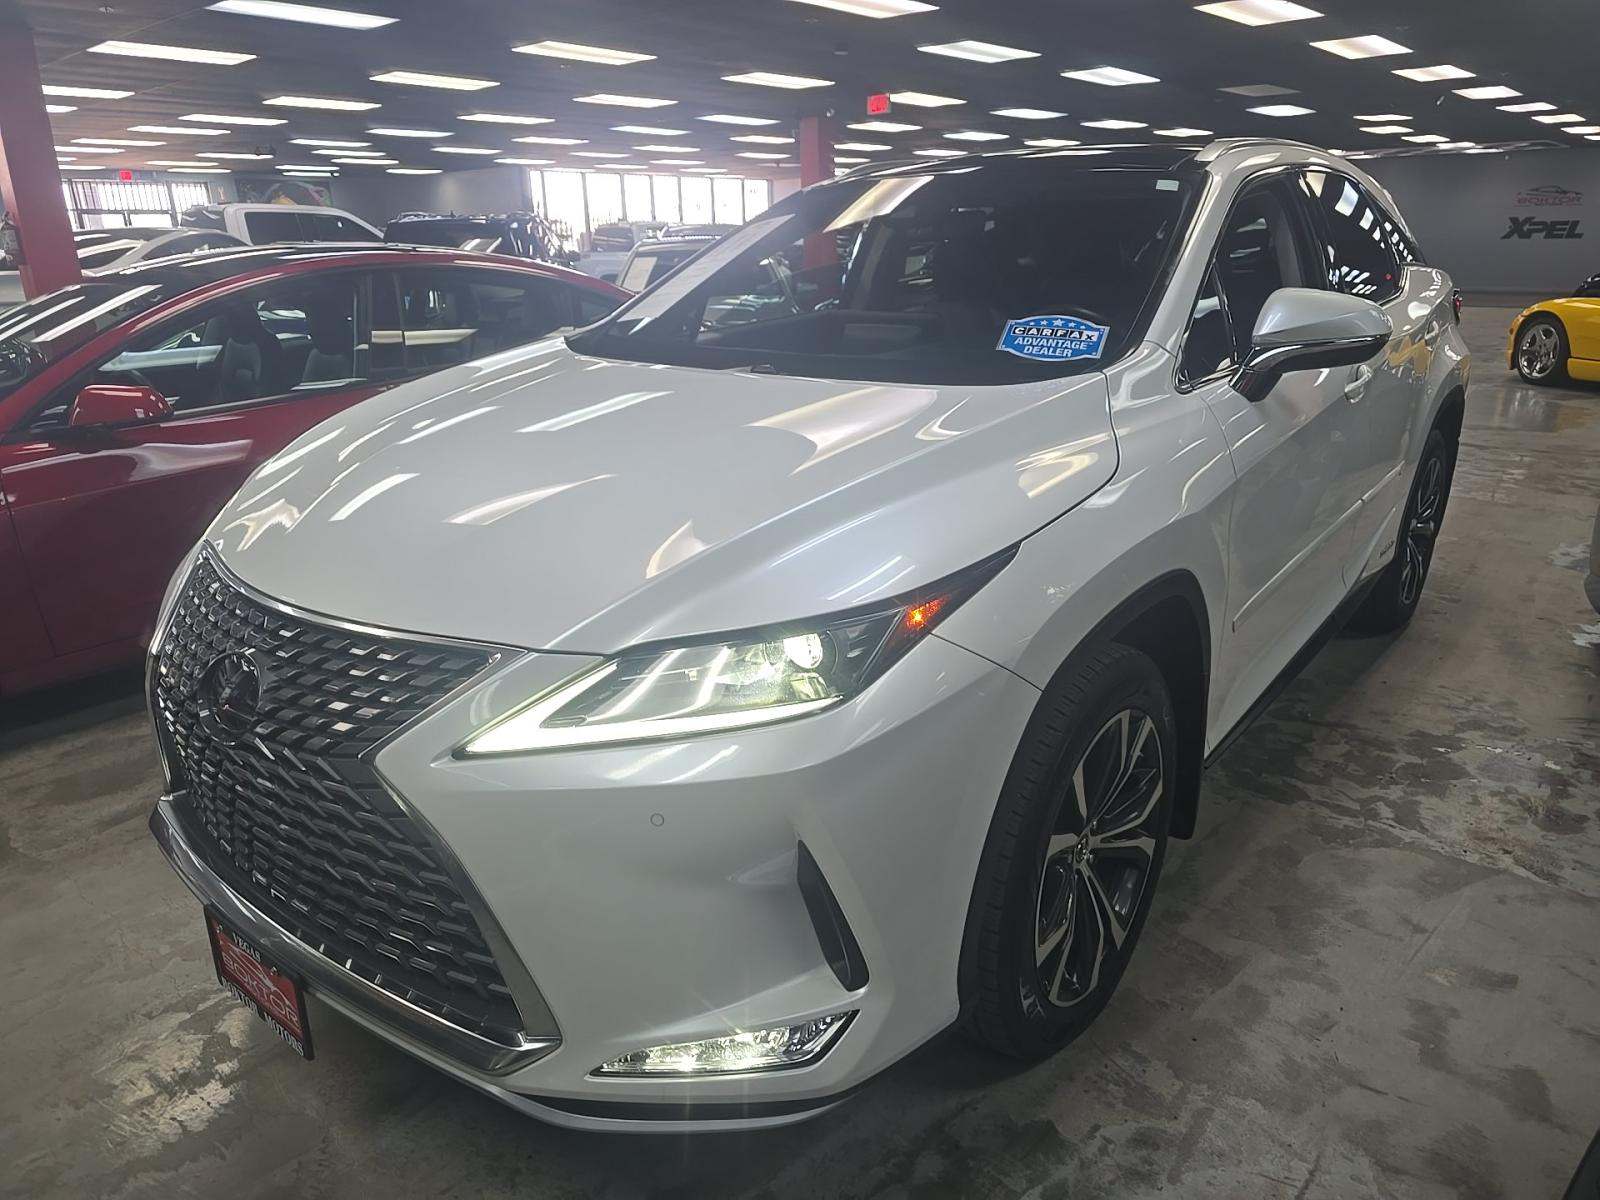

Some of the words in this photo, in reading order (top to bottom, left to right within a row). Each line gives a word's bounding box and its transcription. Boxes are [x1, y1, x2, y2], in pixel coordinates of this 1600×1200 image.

[1500, 217, 1584, 239] XPEL
[1011, 327, 1097, 341] CARFAX
[1014, 337, 1089, 350] ADVANTAGE
[1023, 345, 1072, 357] DEALER
[232, 932, 261, 962] VEGAS
